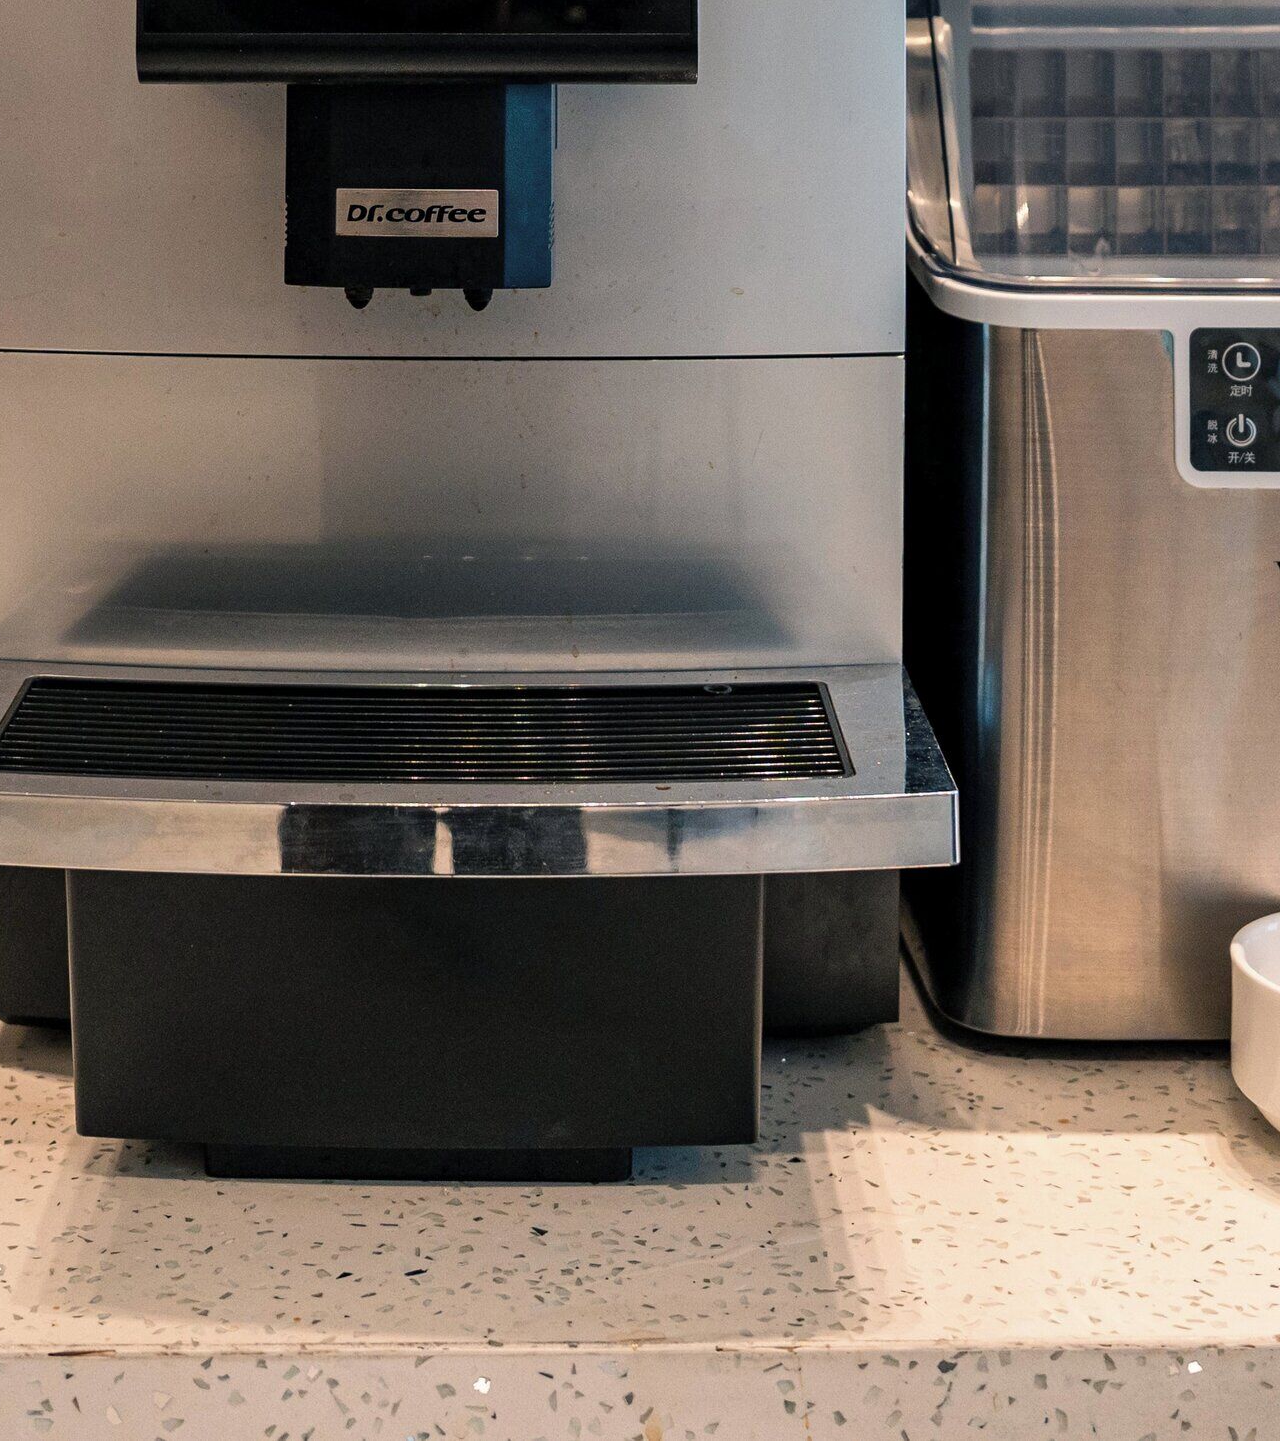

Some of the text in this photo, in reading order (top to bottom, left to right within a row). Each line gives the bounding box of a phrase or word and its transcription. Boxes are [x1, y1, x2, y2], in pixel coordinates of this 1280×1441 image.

[347, 204, 487, 223] Dr.coffee
[1207, 349, 1219, 374] 清洗
[1229, 384, 1253, 397] 定时
[1207, 419, 1219, 444] 脱冰
[1227, 451, 1256, 464] 开/关
